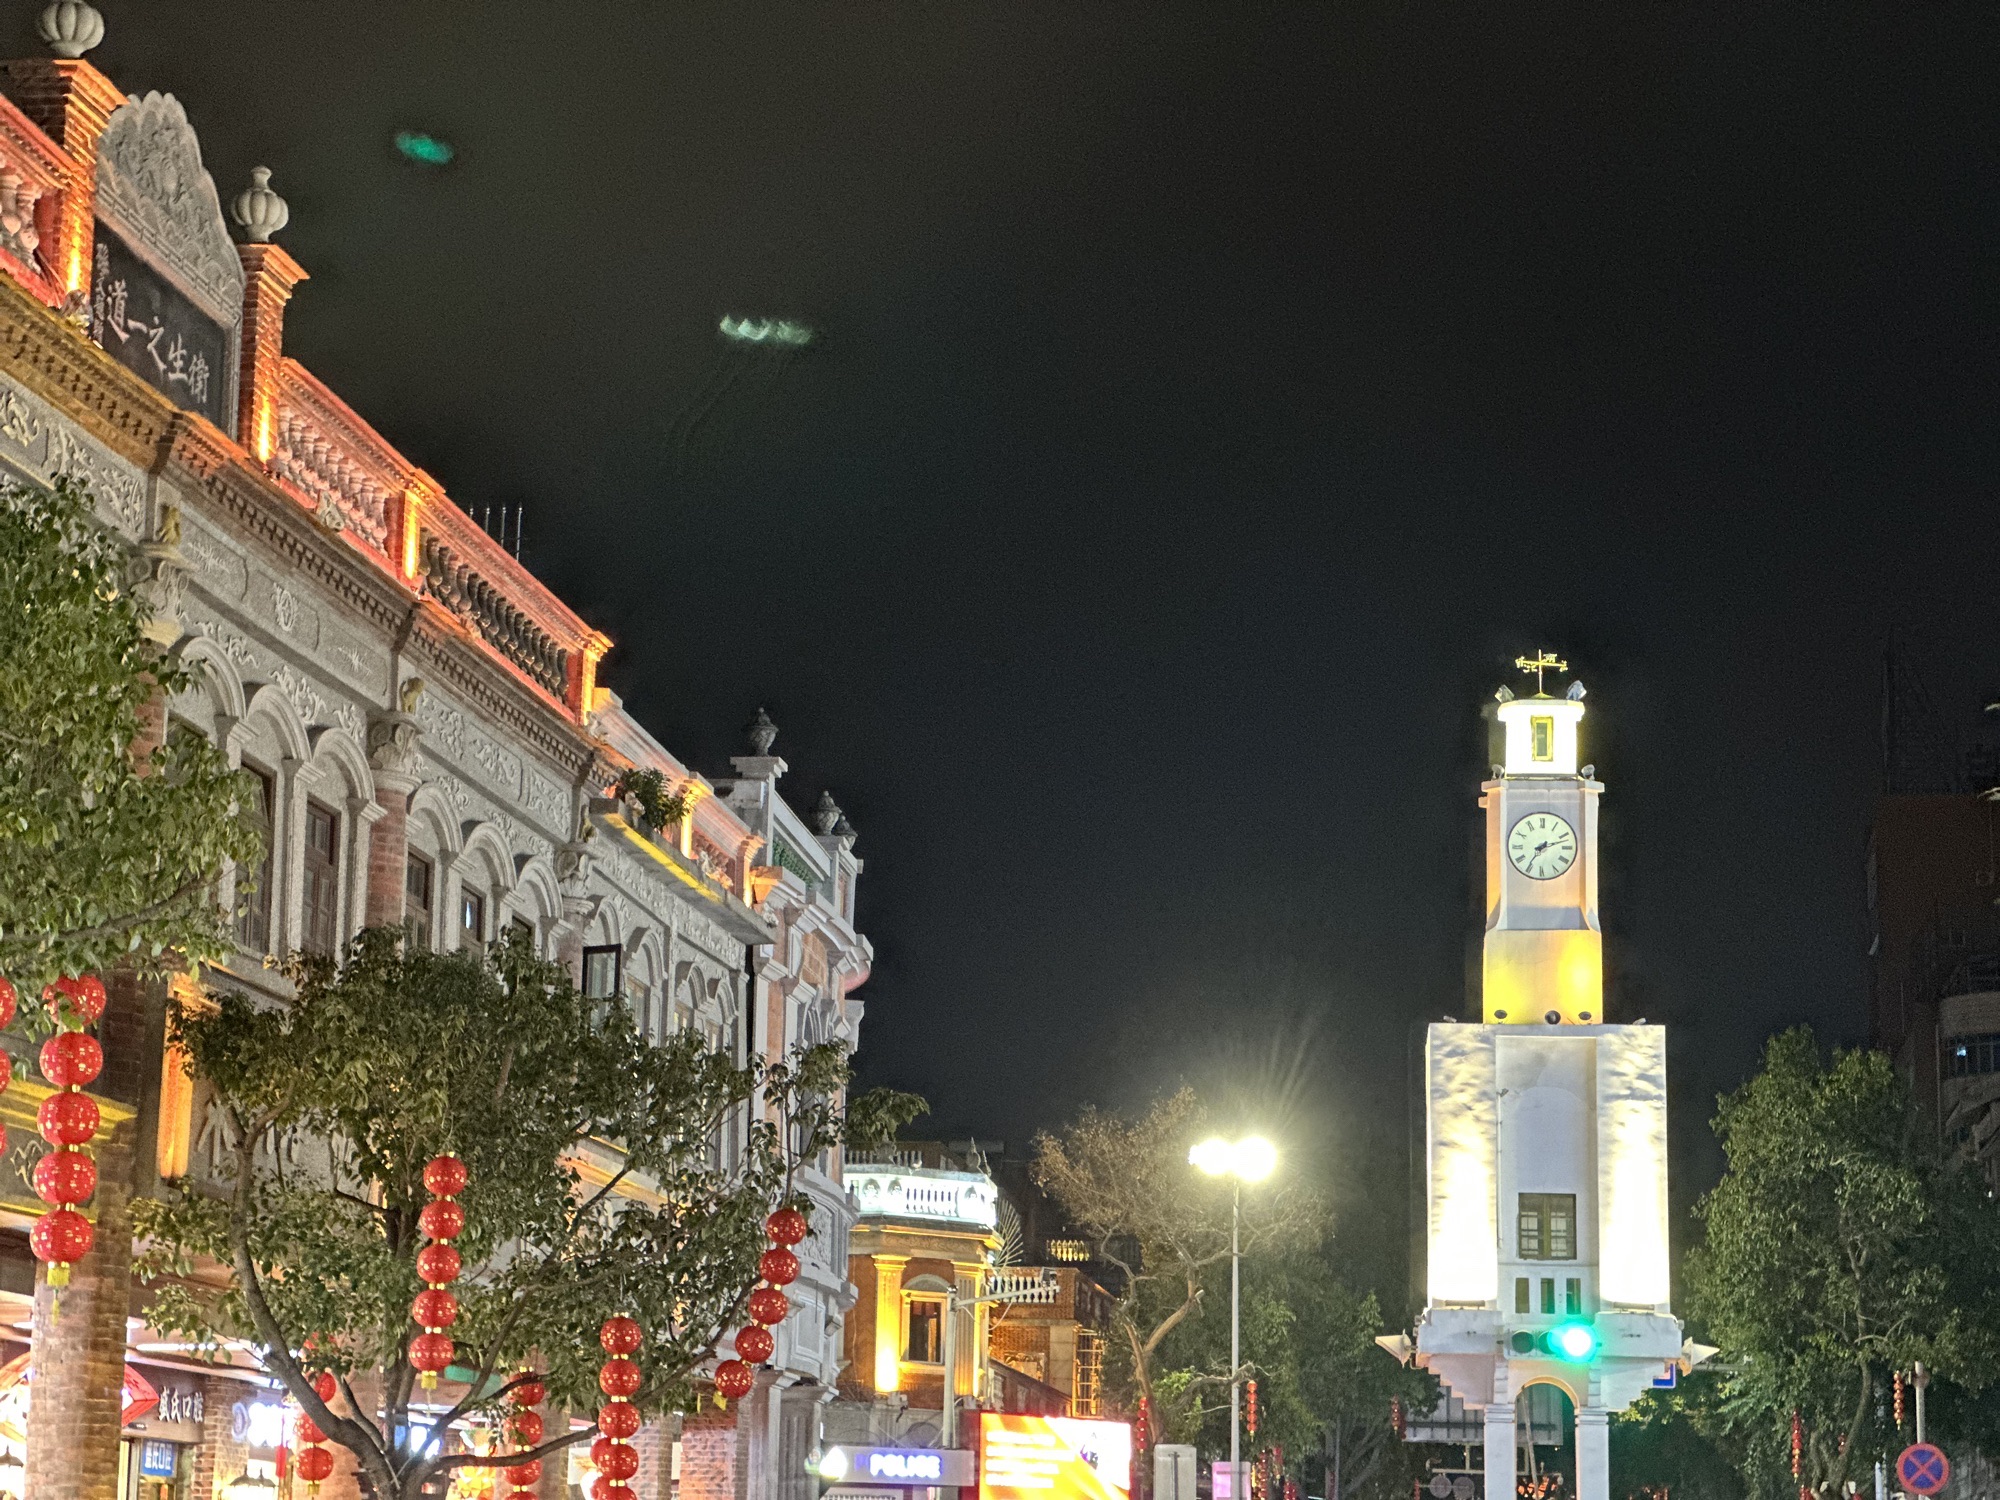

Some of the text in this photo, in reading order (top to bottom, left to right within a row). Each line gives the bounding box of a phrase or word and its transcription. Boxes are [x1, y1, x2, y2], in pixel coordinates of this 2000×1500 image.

[158, 1386, 204, 1424] 盛氏口腔
[869, 1453, 942, 1479] POLICE
